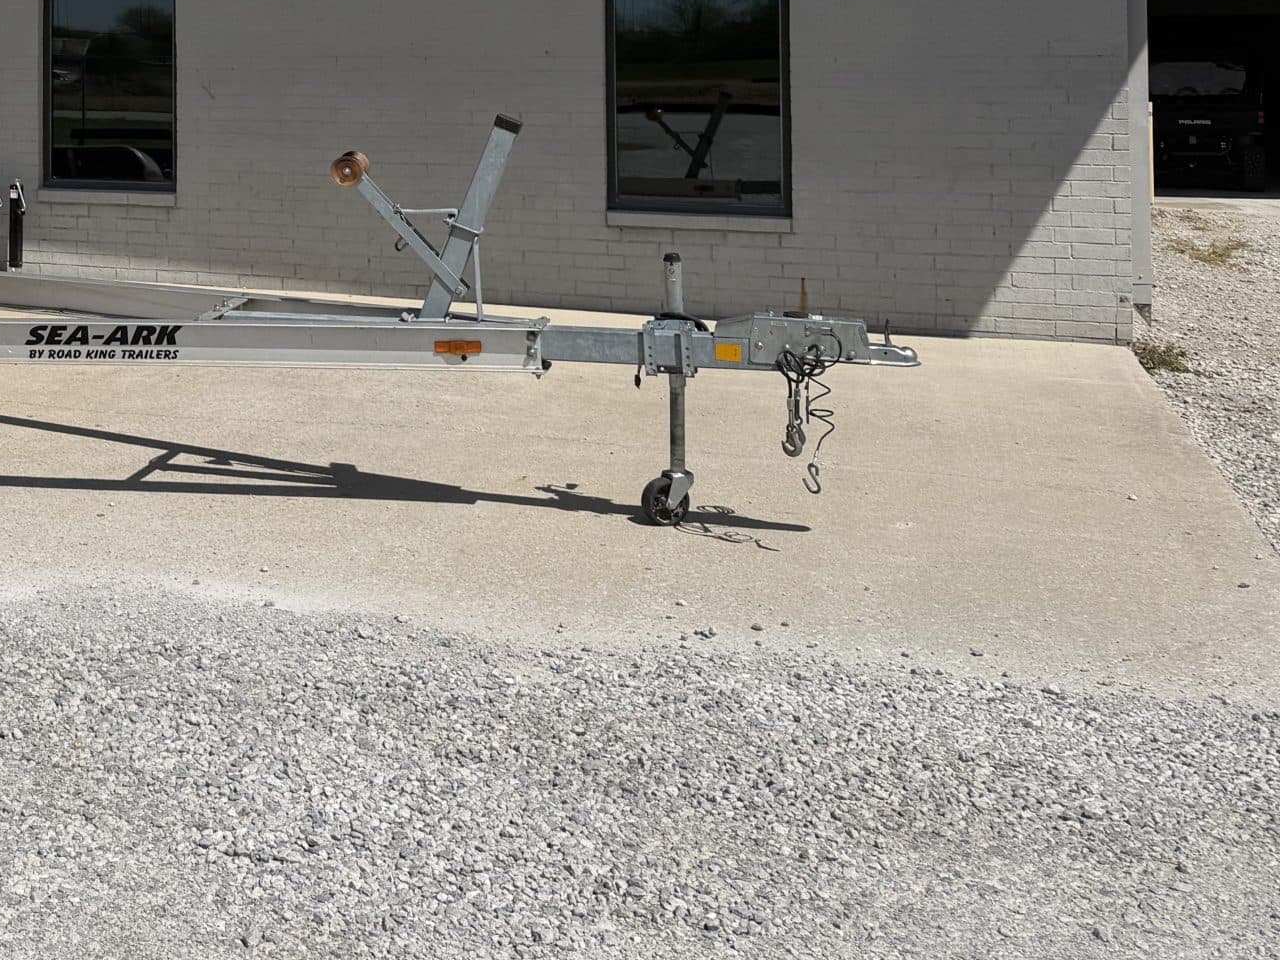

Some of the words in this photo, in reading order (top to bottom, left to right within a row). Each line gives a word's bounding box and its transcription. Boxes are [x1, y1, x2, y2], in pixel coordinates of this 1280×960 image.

[25, 325, 183, 346] SEA-ARK
[29, 349, 44, 359] BY
[47, 349, 81, 359] ROAD
[85, 349, 116, 360] KING
[121, 349, 179, 360] TRAILERS
